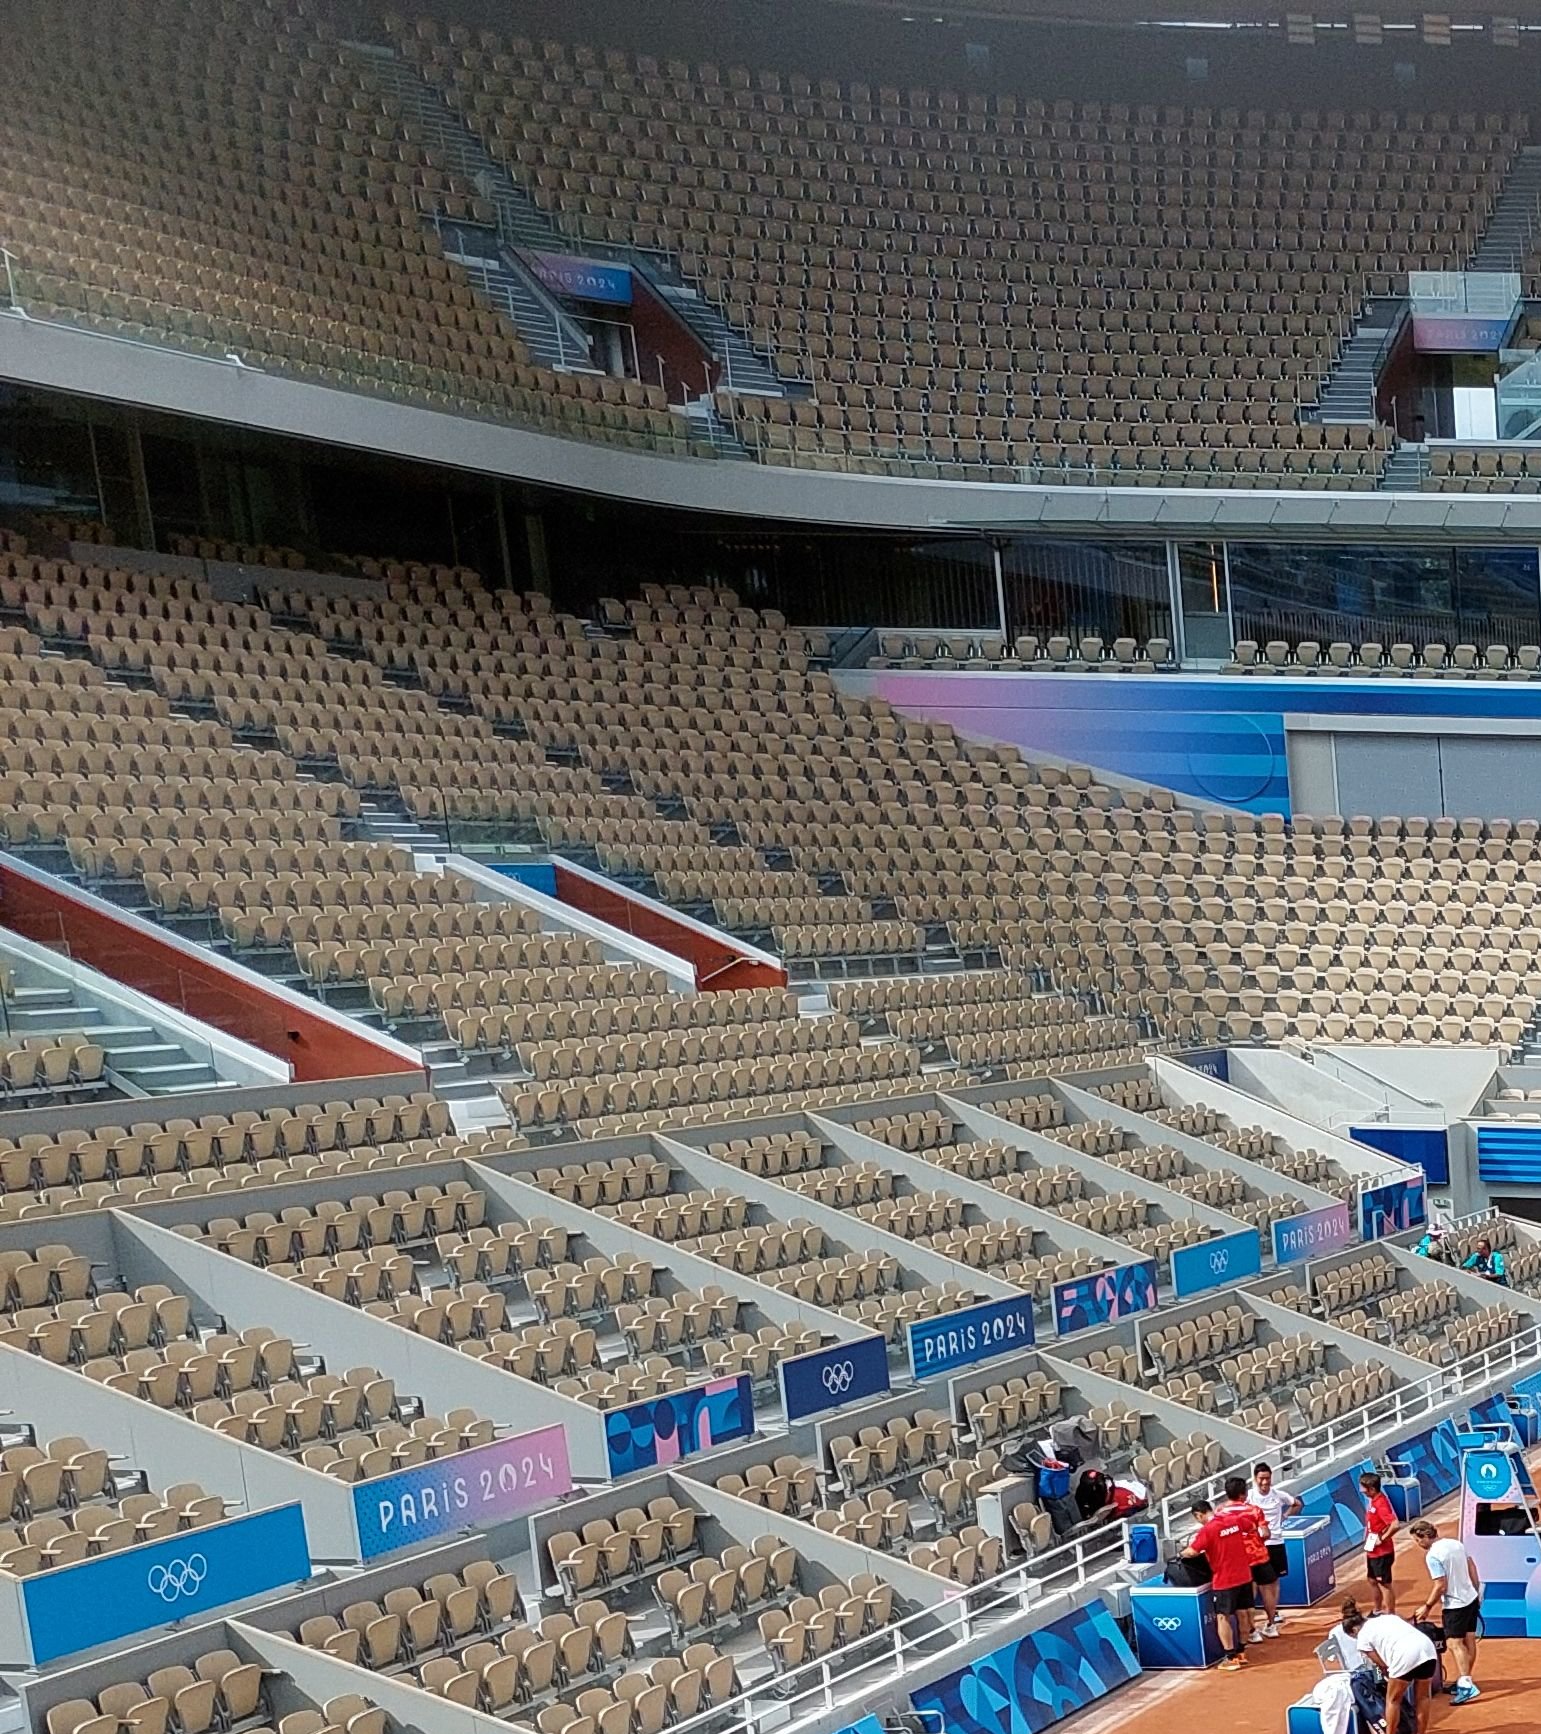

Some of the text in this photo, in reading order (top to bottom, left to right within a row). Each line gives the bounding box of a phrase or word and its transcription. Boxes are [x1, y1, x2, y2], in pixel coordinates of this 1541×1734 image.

[1282, 1217, 1345, 1252] PARIS 2024
[924, 1312, 1026, 1362] PARIS 2024
[379, 1453, 555, 1533] PARIS 2024
